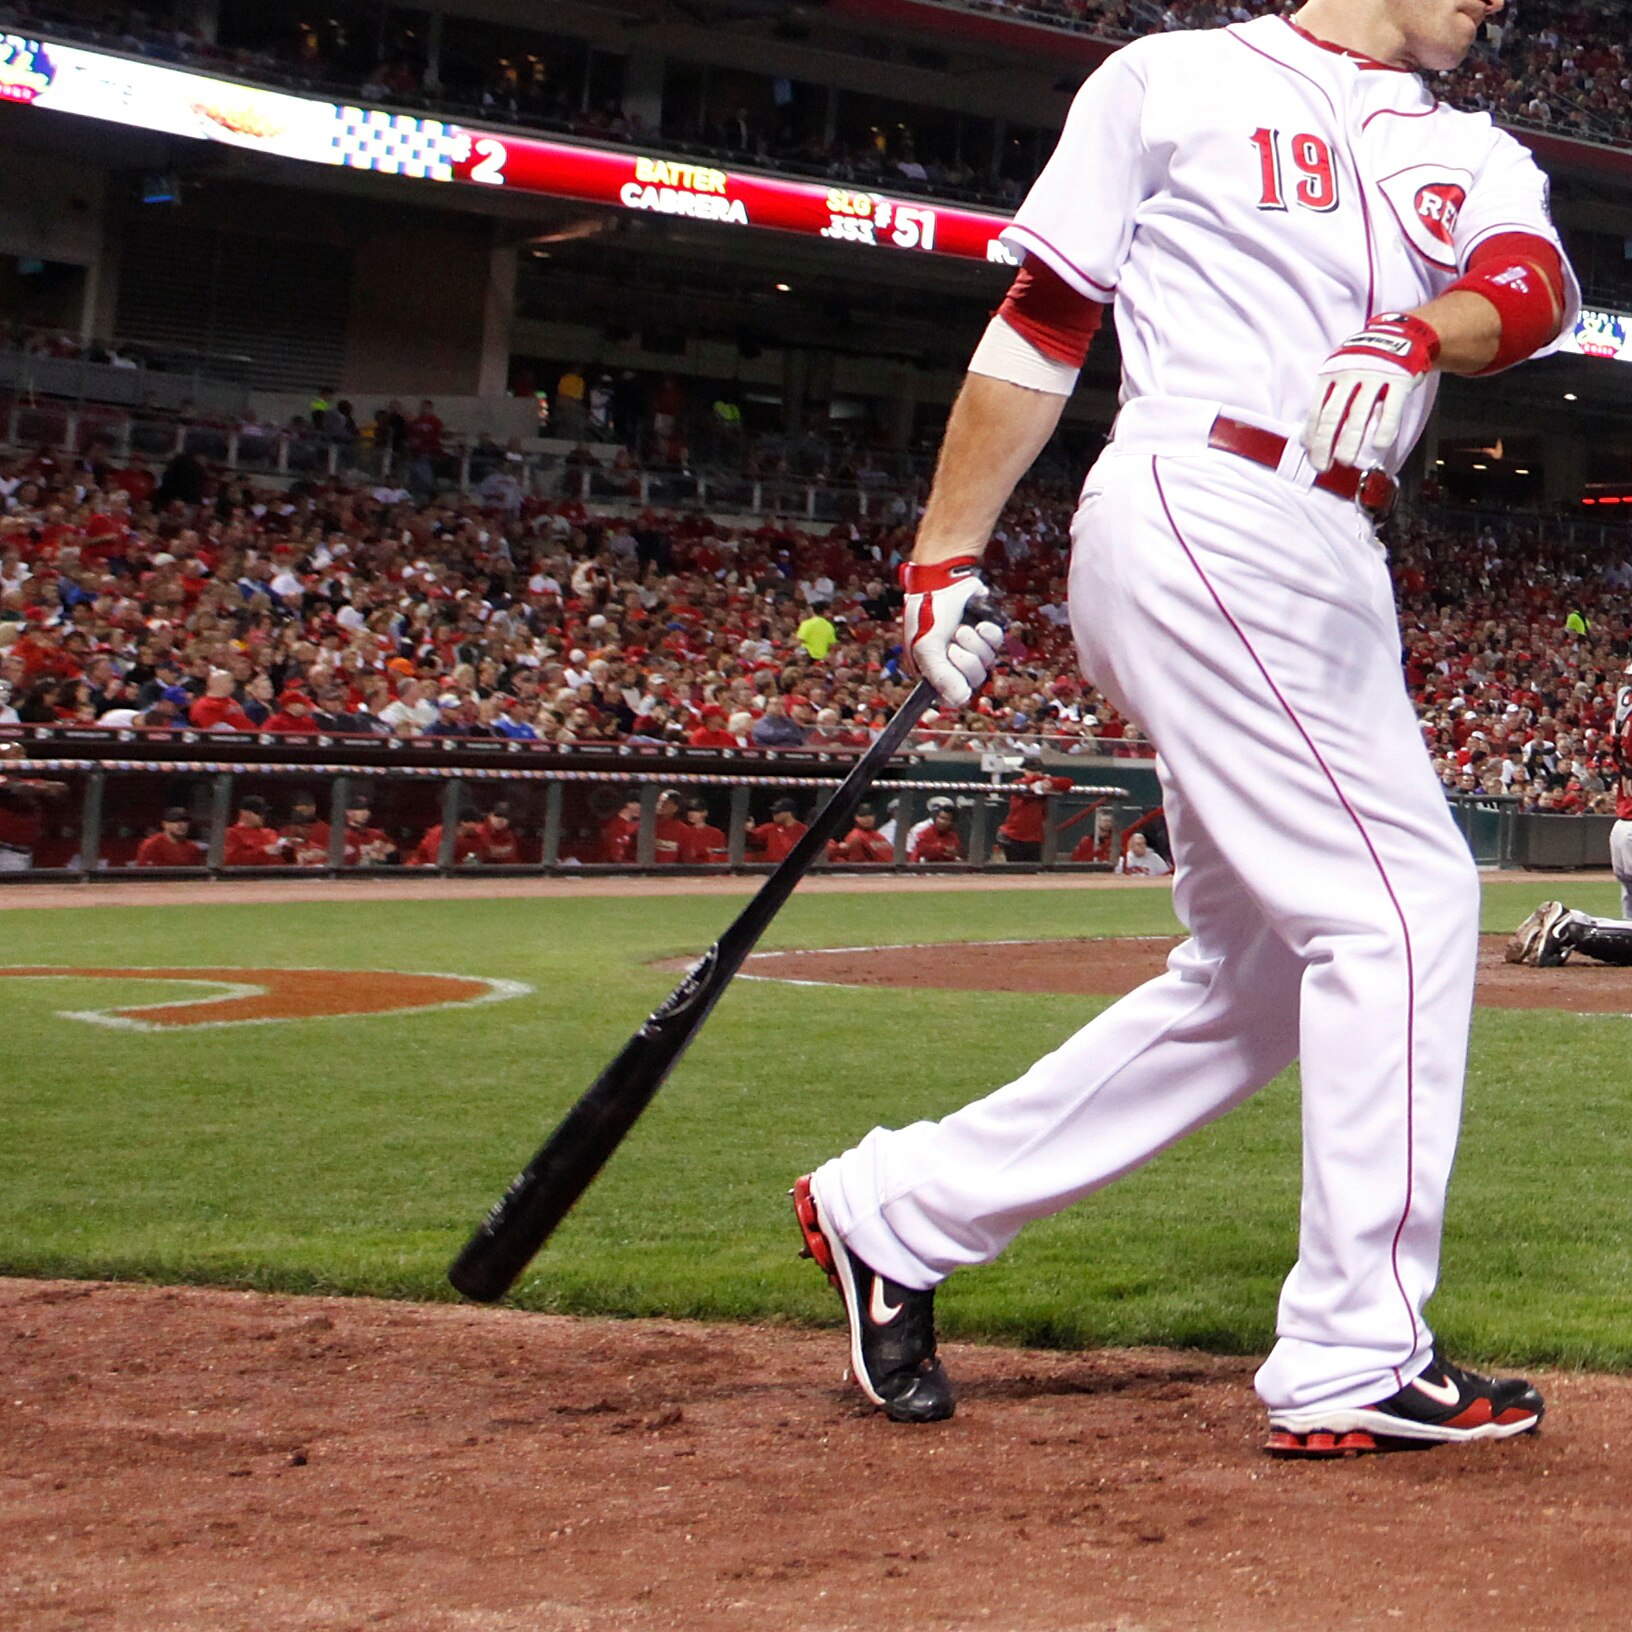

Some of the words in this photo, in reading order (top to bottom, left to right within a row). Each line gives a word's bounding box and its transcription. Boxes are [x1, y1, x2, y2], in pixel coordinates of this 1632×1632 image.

[635, 156, 728, 194] BATTER
[1249, 126, 1340, 214] 19
[619, 182, 749, 225] CABRERA
[826, 188, 872, 217] SLG
